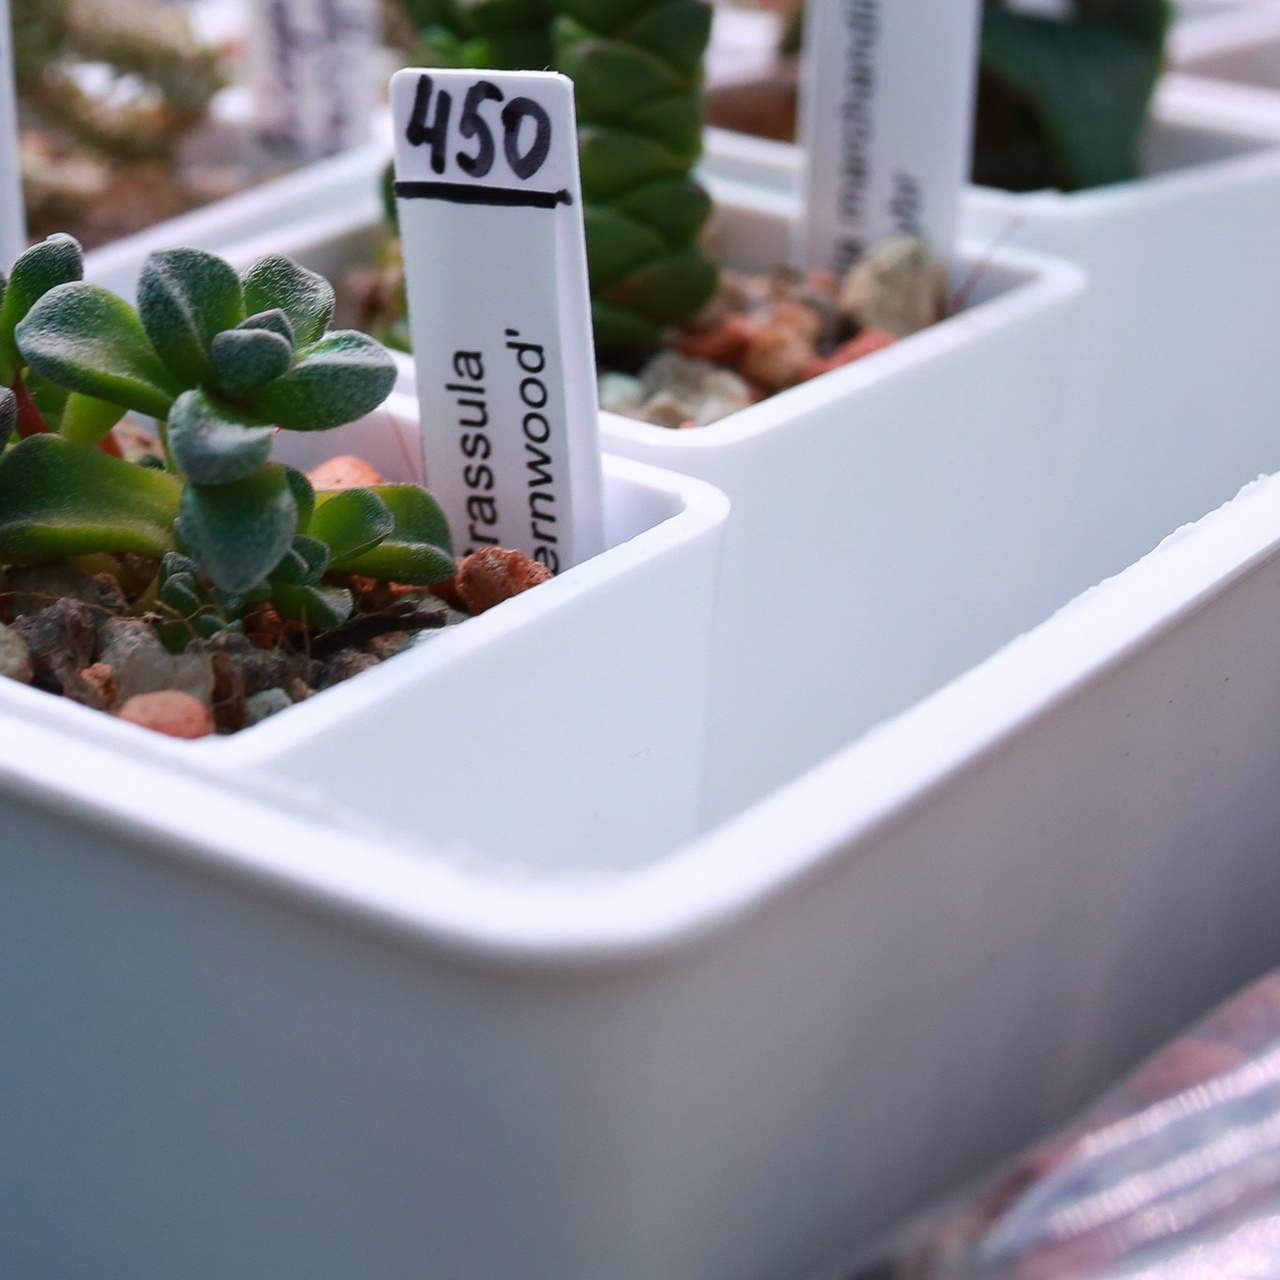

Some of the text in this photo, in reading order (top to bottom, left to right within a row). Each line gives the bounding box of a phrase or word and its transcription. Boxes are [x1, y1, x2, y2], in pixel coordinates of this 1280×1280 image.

[405, 73, 552, 180] 450
[444, 350, 500, 556] rassula
[504, 328, 560, 575] ernwood'
